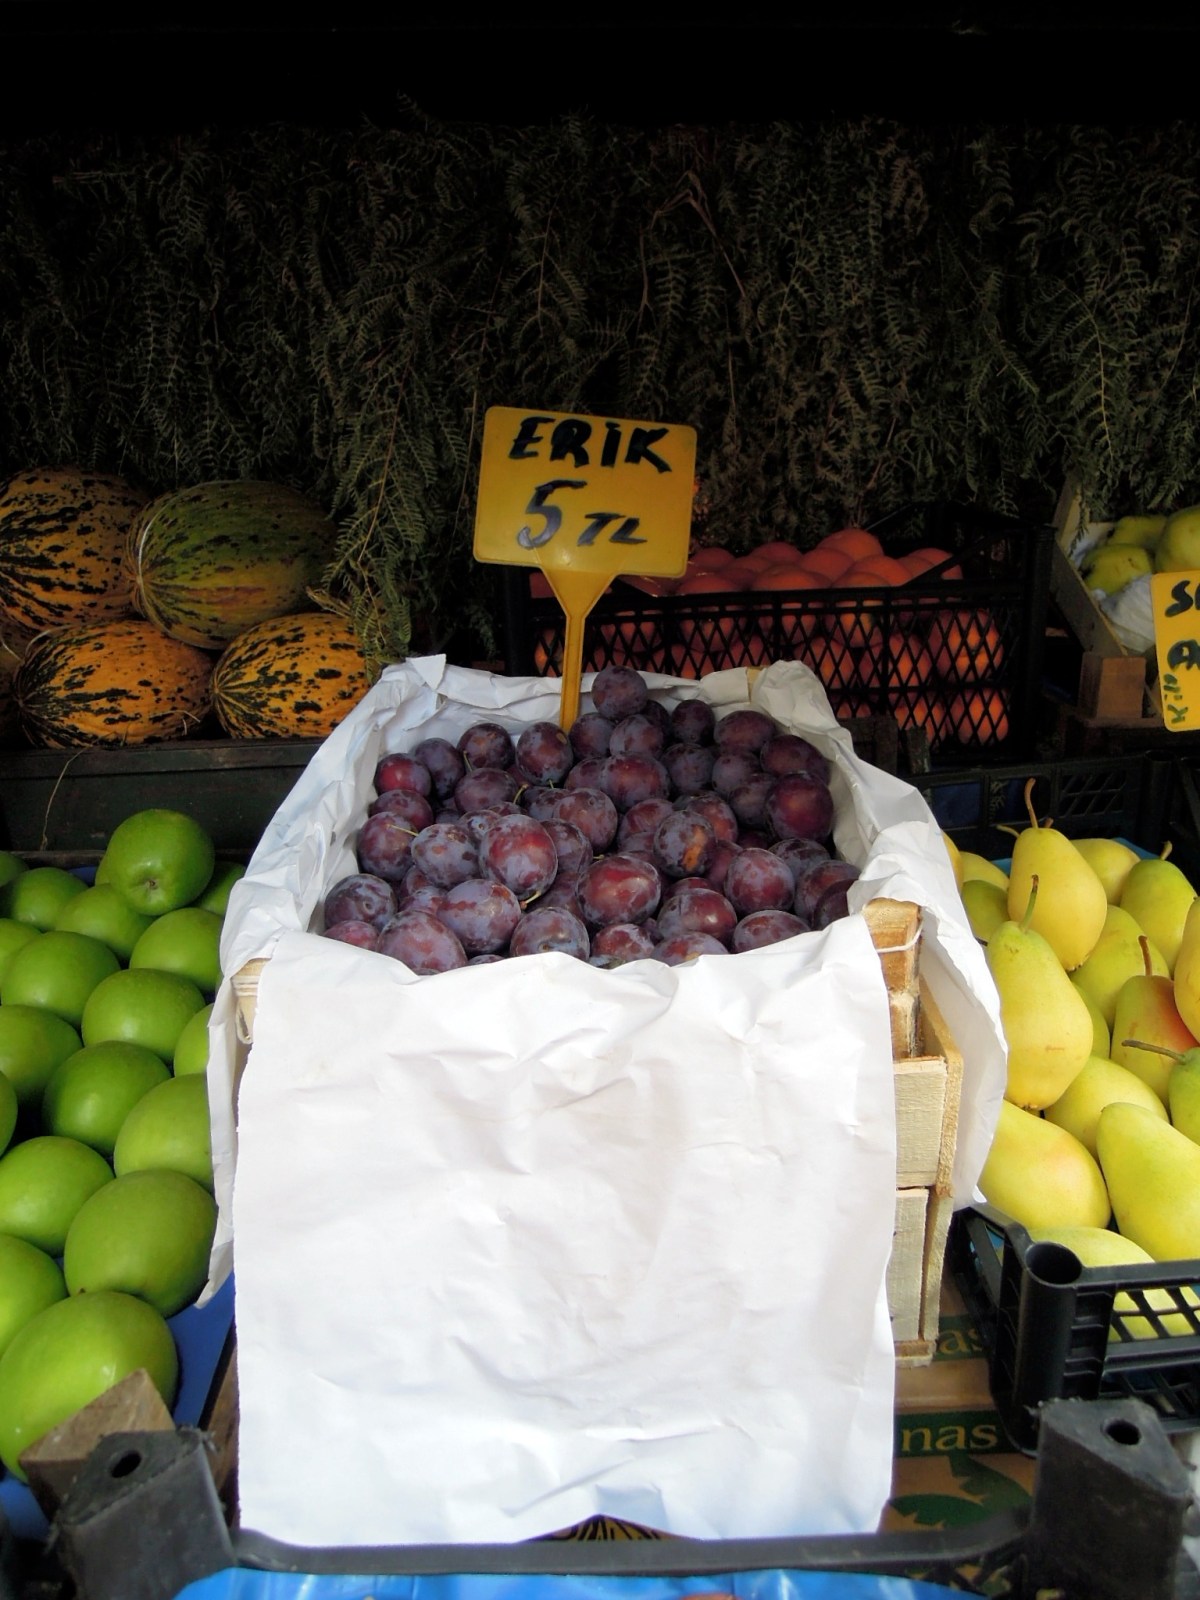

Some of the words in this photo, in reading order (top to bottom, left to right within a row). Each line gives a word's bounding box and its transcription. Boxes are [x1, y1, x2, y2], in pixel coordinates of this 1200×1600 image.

[516, 479, 588, 550] 5
[577, 512, 648, 547] TL
[901, 1423, 999, 1453] nas
